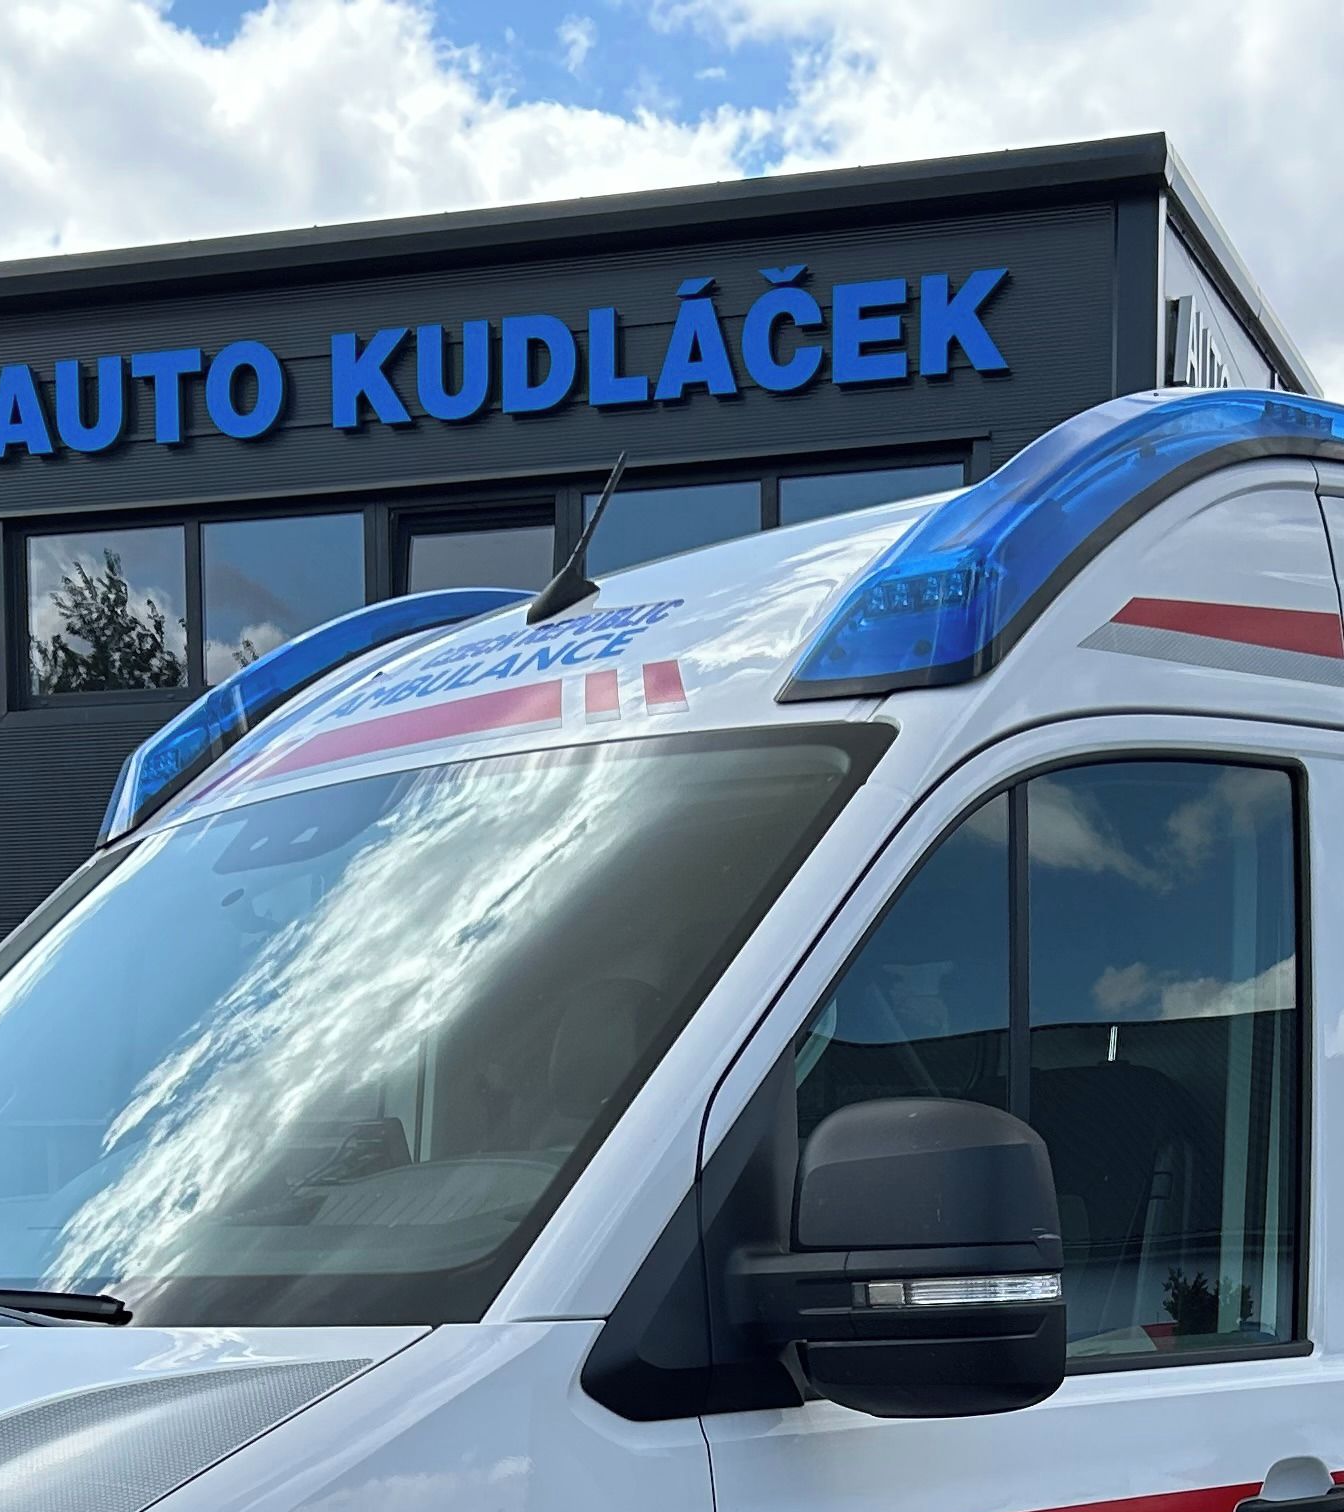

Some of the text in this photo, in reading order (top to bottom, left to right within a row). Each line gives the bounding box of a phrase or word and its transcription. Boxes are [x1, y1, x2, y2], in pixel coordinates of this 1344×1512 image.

[331, 264, 1009, 430] KUDLÁČEK
[513, 599, 685, 648] REPUBLIC
[312, 626, 648, 725] AMBULANCE
